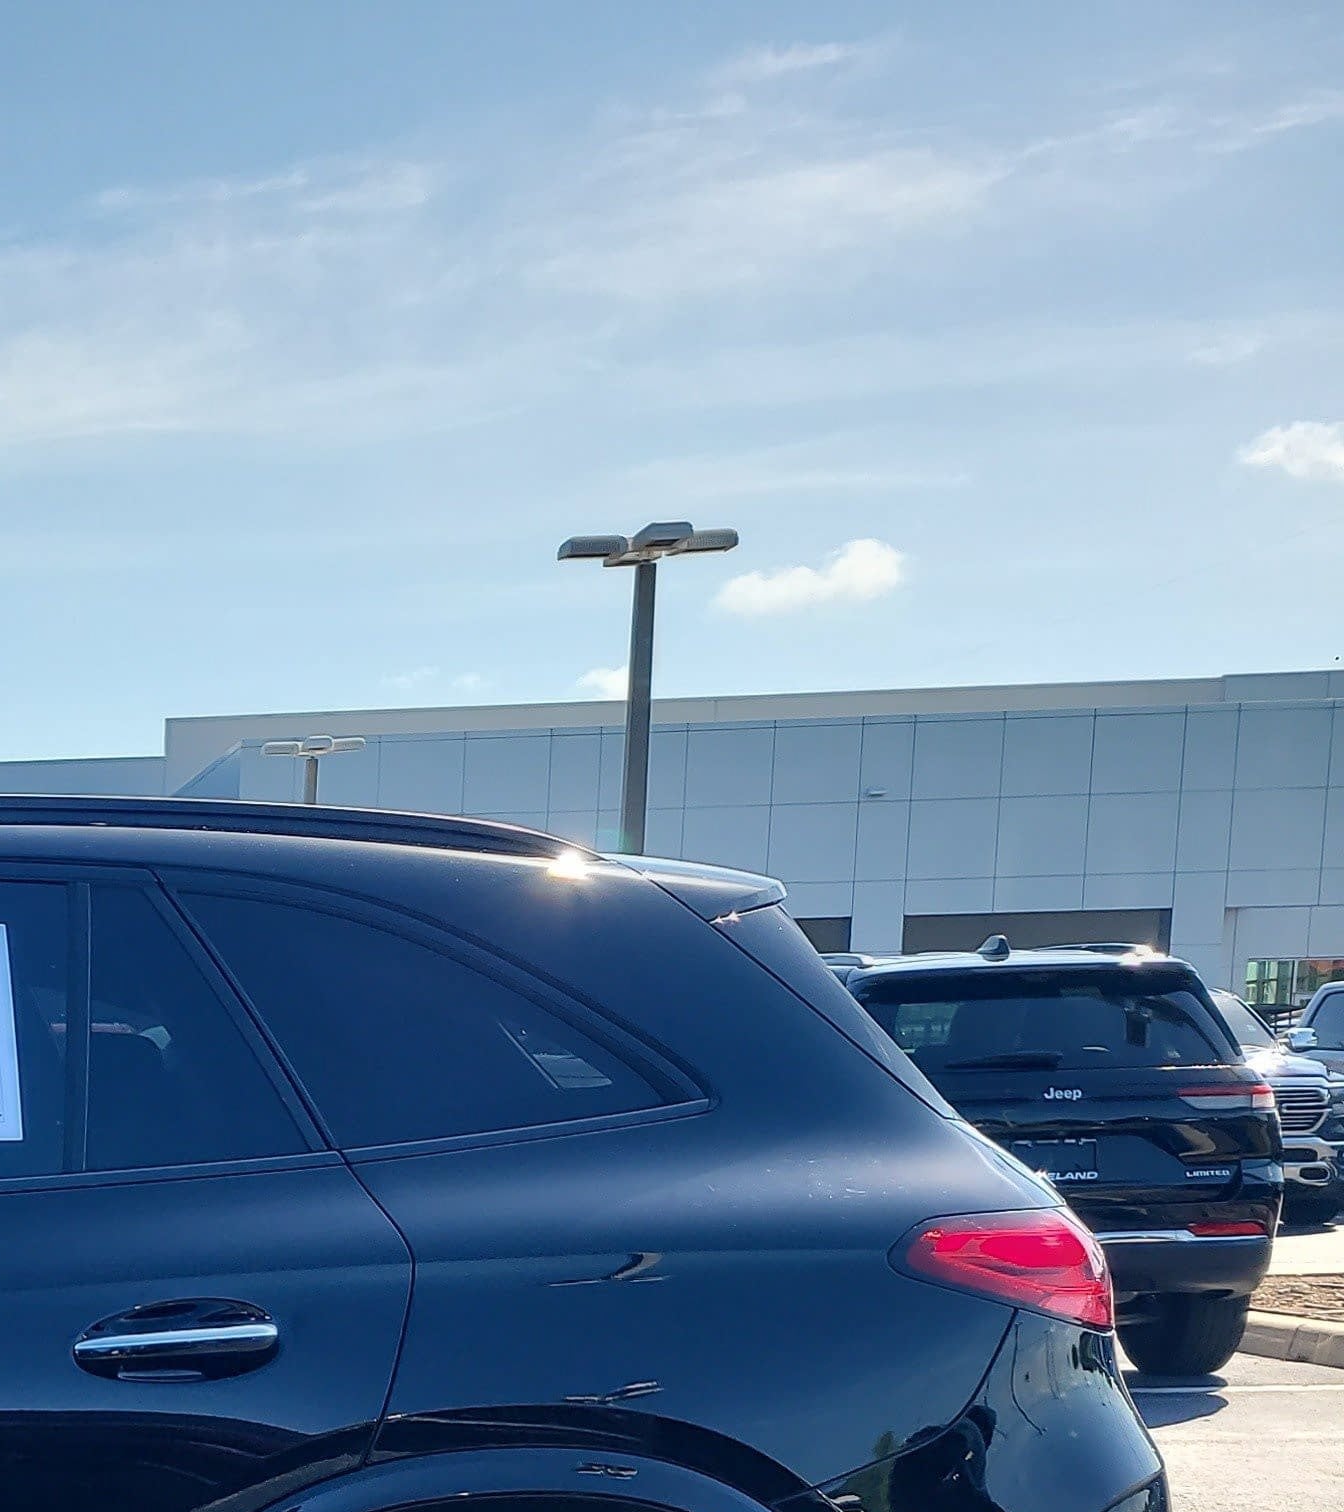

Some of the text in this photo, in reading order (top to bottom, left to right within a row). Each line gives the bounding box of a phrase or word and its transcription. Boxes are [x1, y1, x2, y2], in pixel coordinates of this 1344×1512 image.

[1043, 1087, 1082, 1100] Jeep
[1046, 1170, 1099, 1181] ELAND
[1185, 1168, 1231, 1177] LIMITED
